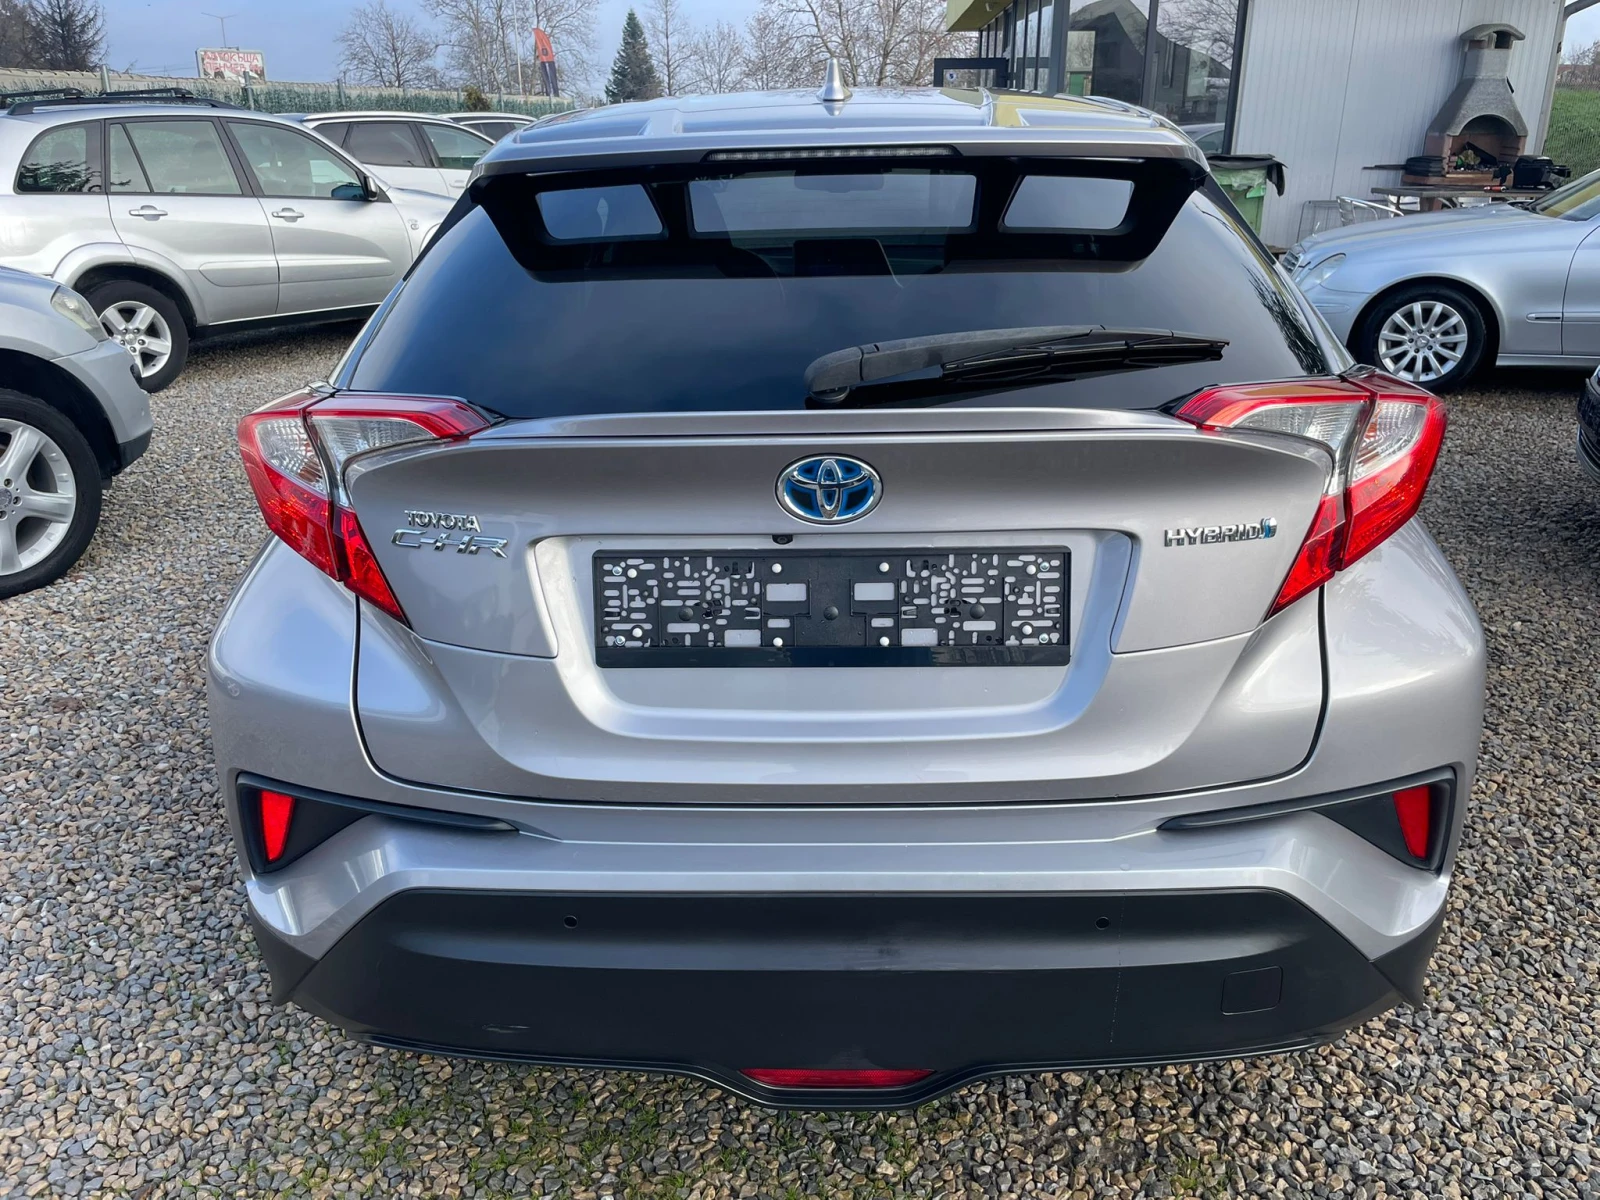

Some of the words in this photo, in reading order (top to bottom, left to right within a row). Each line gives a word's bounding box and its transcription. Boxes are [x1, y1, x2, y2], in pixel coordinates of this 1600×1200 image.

[404, 510, 481, 532] TOYOTA
[391, 528, 508, 558] C-HR
[1164, 523, 1261, 547] HYBRID
